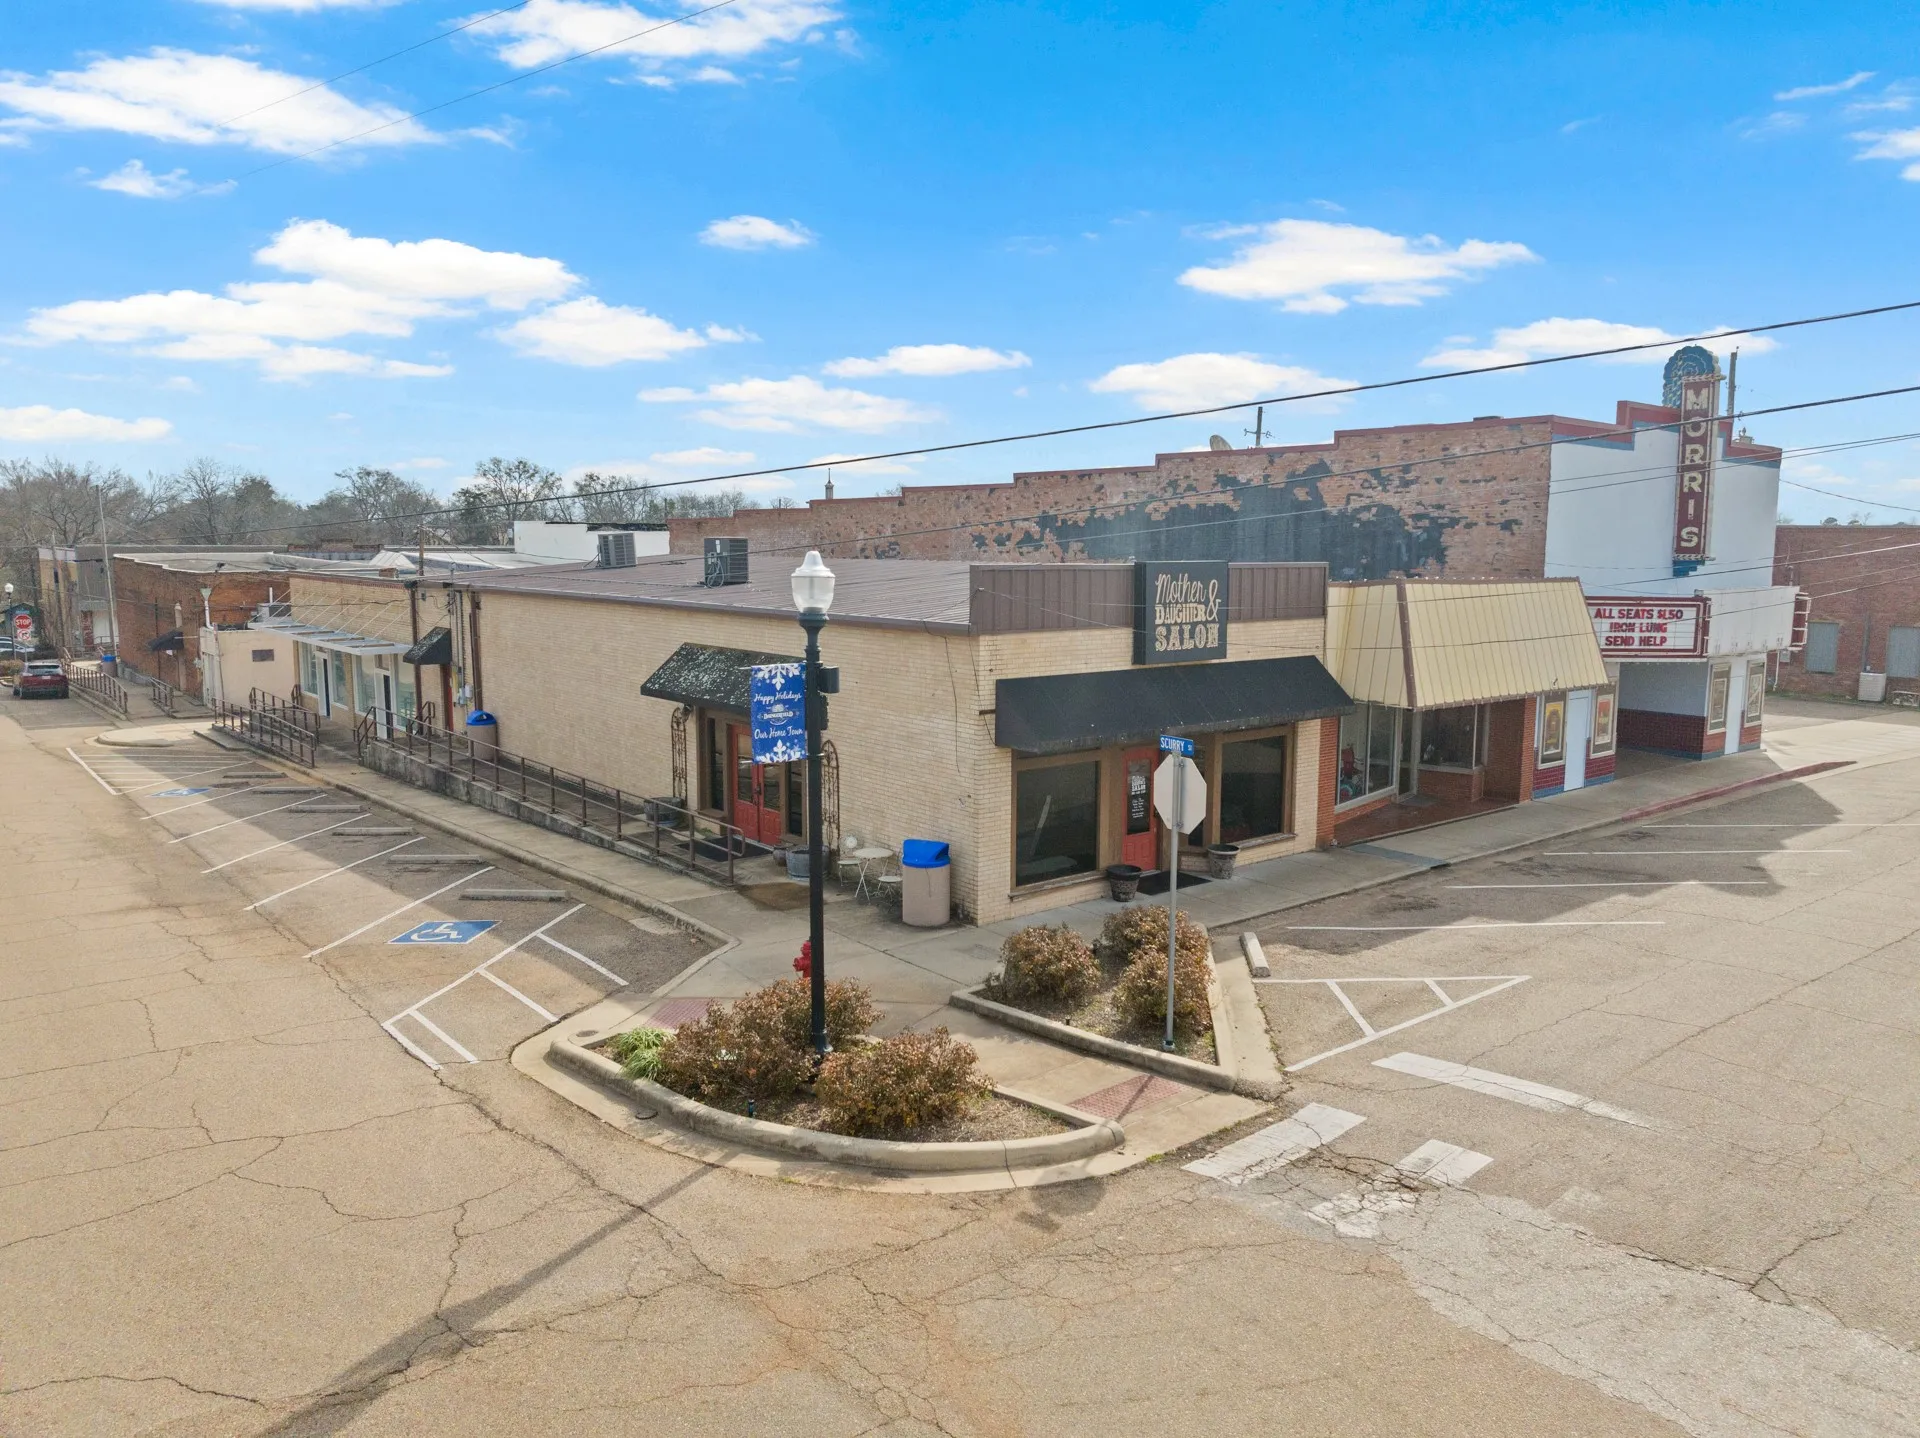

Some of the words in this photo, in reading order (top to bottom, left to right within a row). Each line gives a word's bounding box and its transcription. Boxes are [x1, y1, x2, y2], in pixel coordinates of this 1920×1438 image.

[1680, 388, 1709, 547] MORRIS
[1155, 573, 1207, 603] Mother
[1206, 579, 1221, 621] &
[1155, 603, 1206, 624] DAUGHTER
[1594, 608, 1615, 618] ALL
[1618, 609, 1654, 619] SEATS
[1610, 622, 1635, 632] IRON
[1640, 622, 1668, 632] LUNG
[1155, 624, 1219, 651] SALON
[1605, 636, 1634, 646] SEND
[1639, 636, 1667, 646] HELP
[754, 693, 774, 704] Happy
[774, 691, 802, 702] Holidays
[754, 728, 768, 739] Our
[768, 728, 787, 738] Home
[787, 726, 803, 736] Town
[1160, 737, 1184, 751] SCURRY
